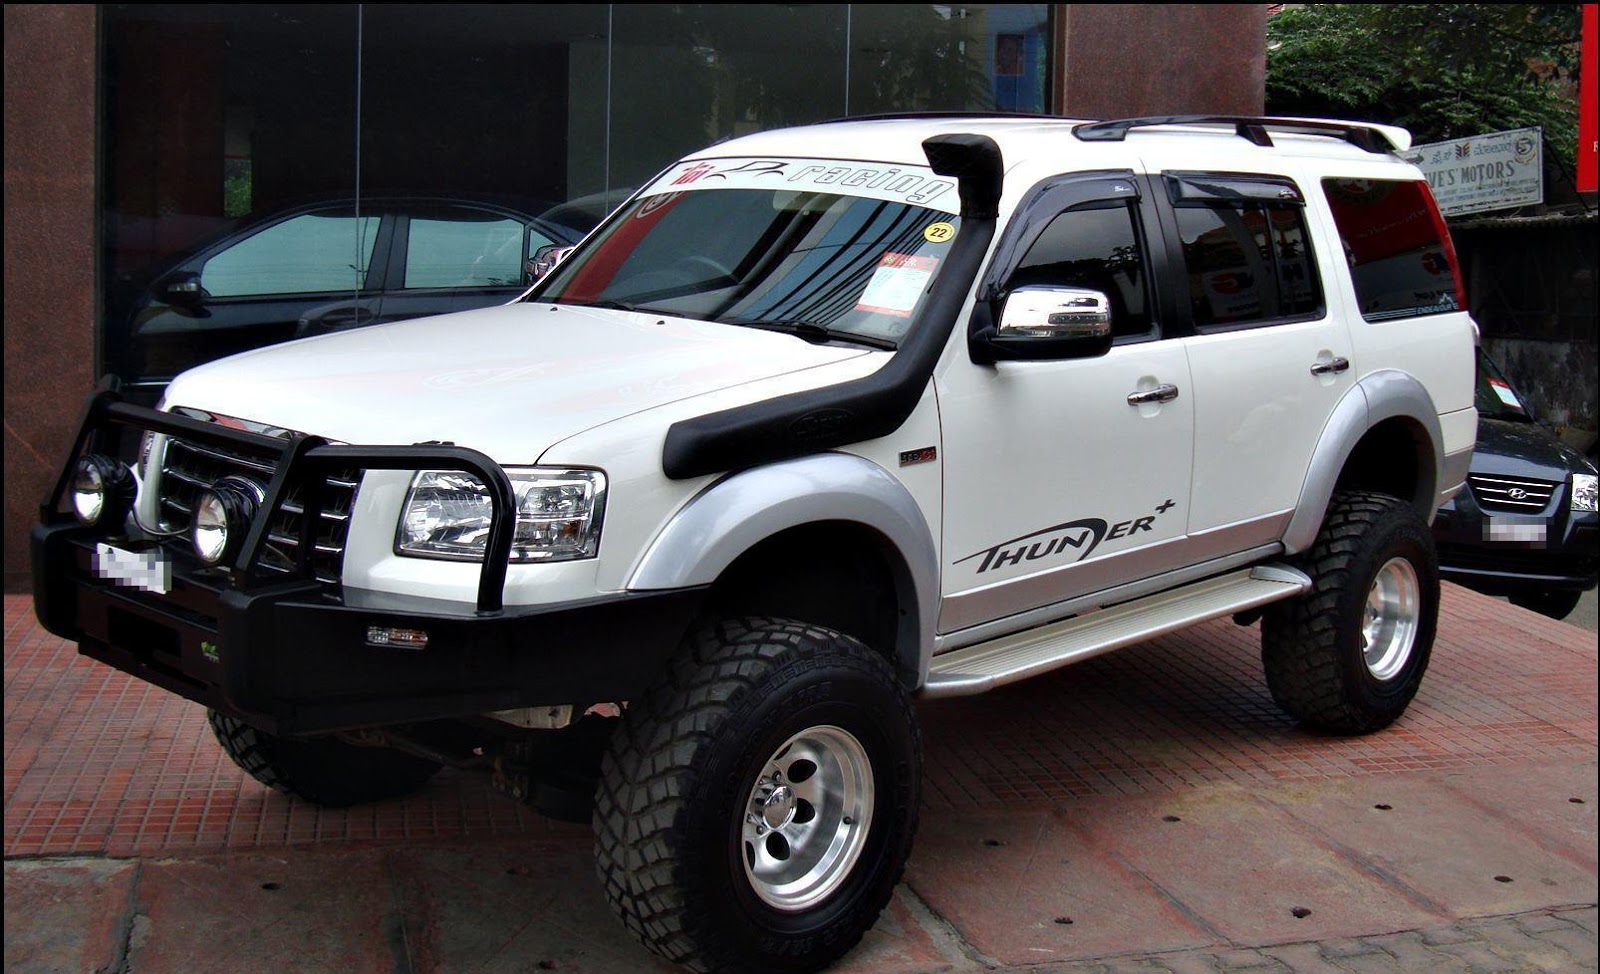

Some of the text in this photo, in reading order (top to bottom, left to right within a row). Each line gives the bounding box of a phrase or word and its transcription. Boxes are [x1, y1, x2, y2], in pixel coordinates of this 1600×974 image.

[788, 165, 954, 204] racing
[1461, 160, 1515, 185] MOTORS
[930, 227, 947, 238] 22
